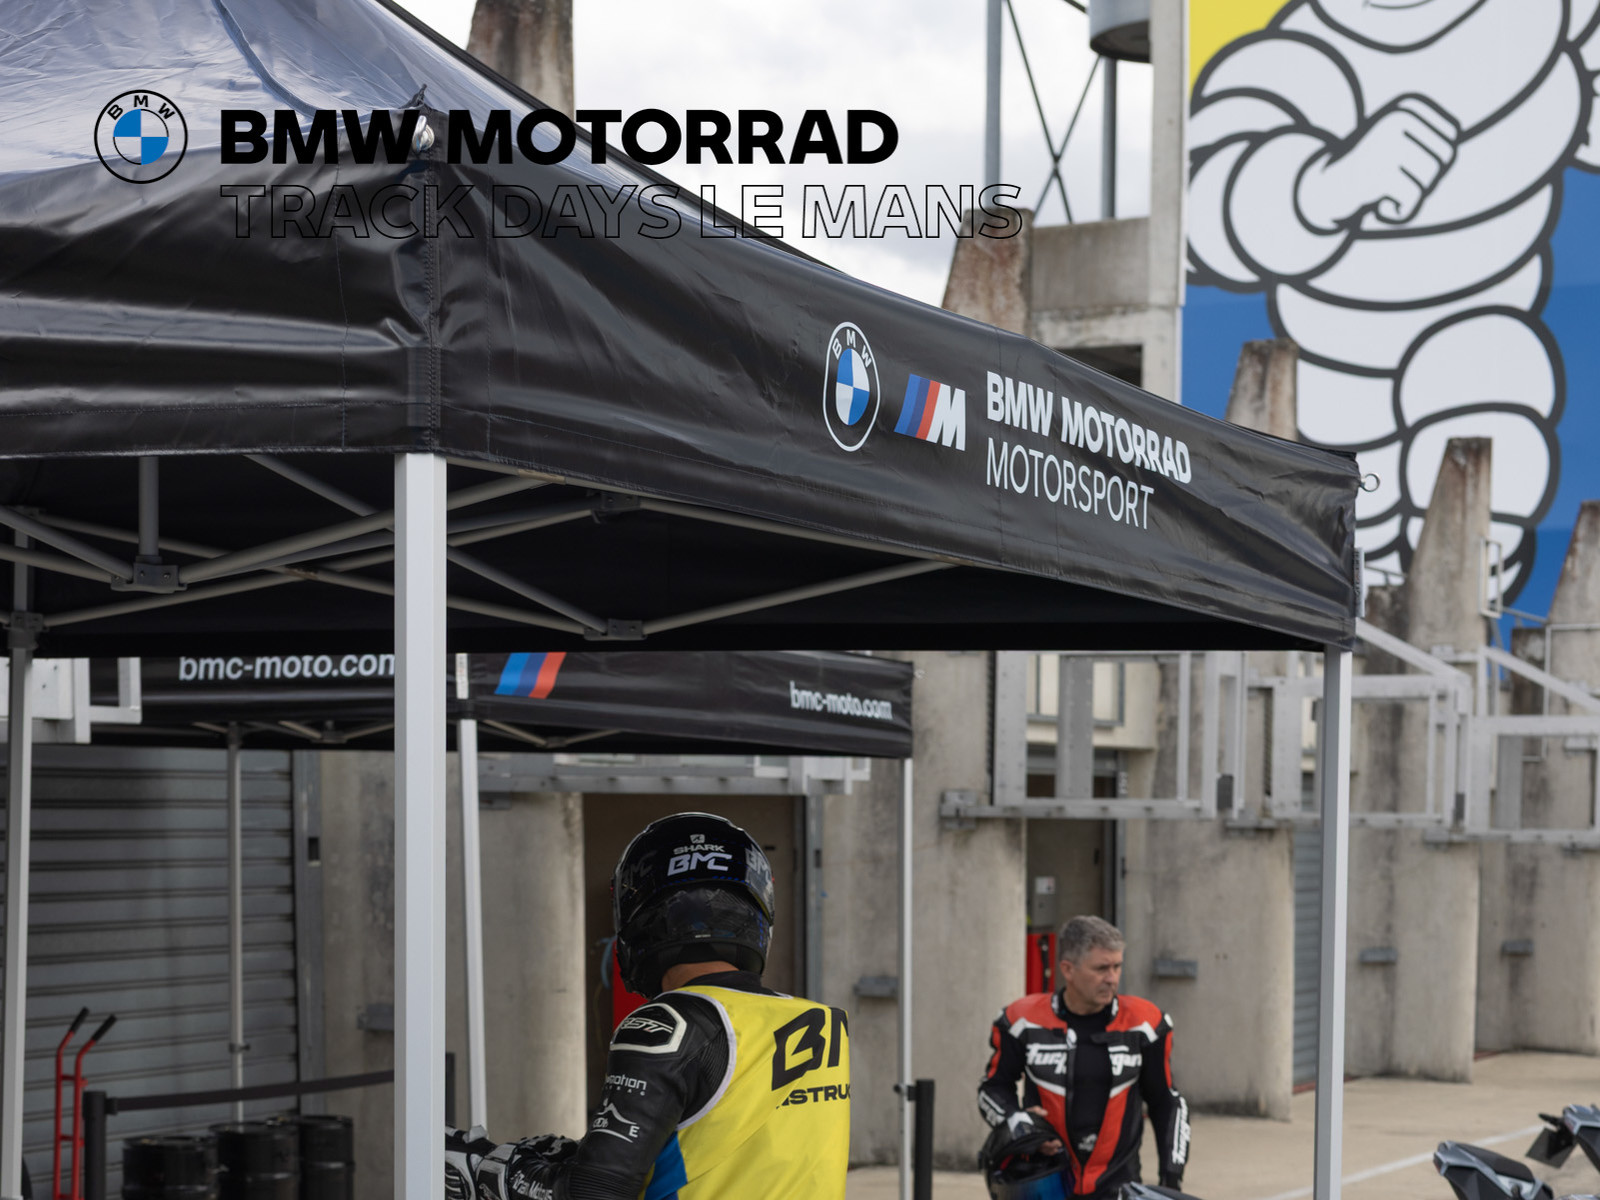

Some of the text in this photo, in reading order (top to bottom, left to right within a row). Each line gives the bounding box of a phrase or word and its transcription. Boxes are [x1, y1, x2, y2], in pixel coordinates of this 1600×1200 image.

[986, 371, 1193, 485] BMW MOTORRAD
[986, 437, 1155, 530] MOTORSPORT
[789, 679, 894, 721] bmc-moto.com
[667, 851, 733, 877] BMC
[673, 844, 726, 855] SHARK
